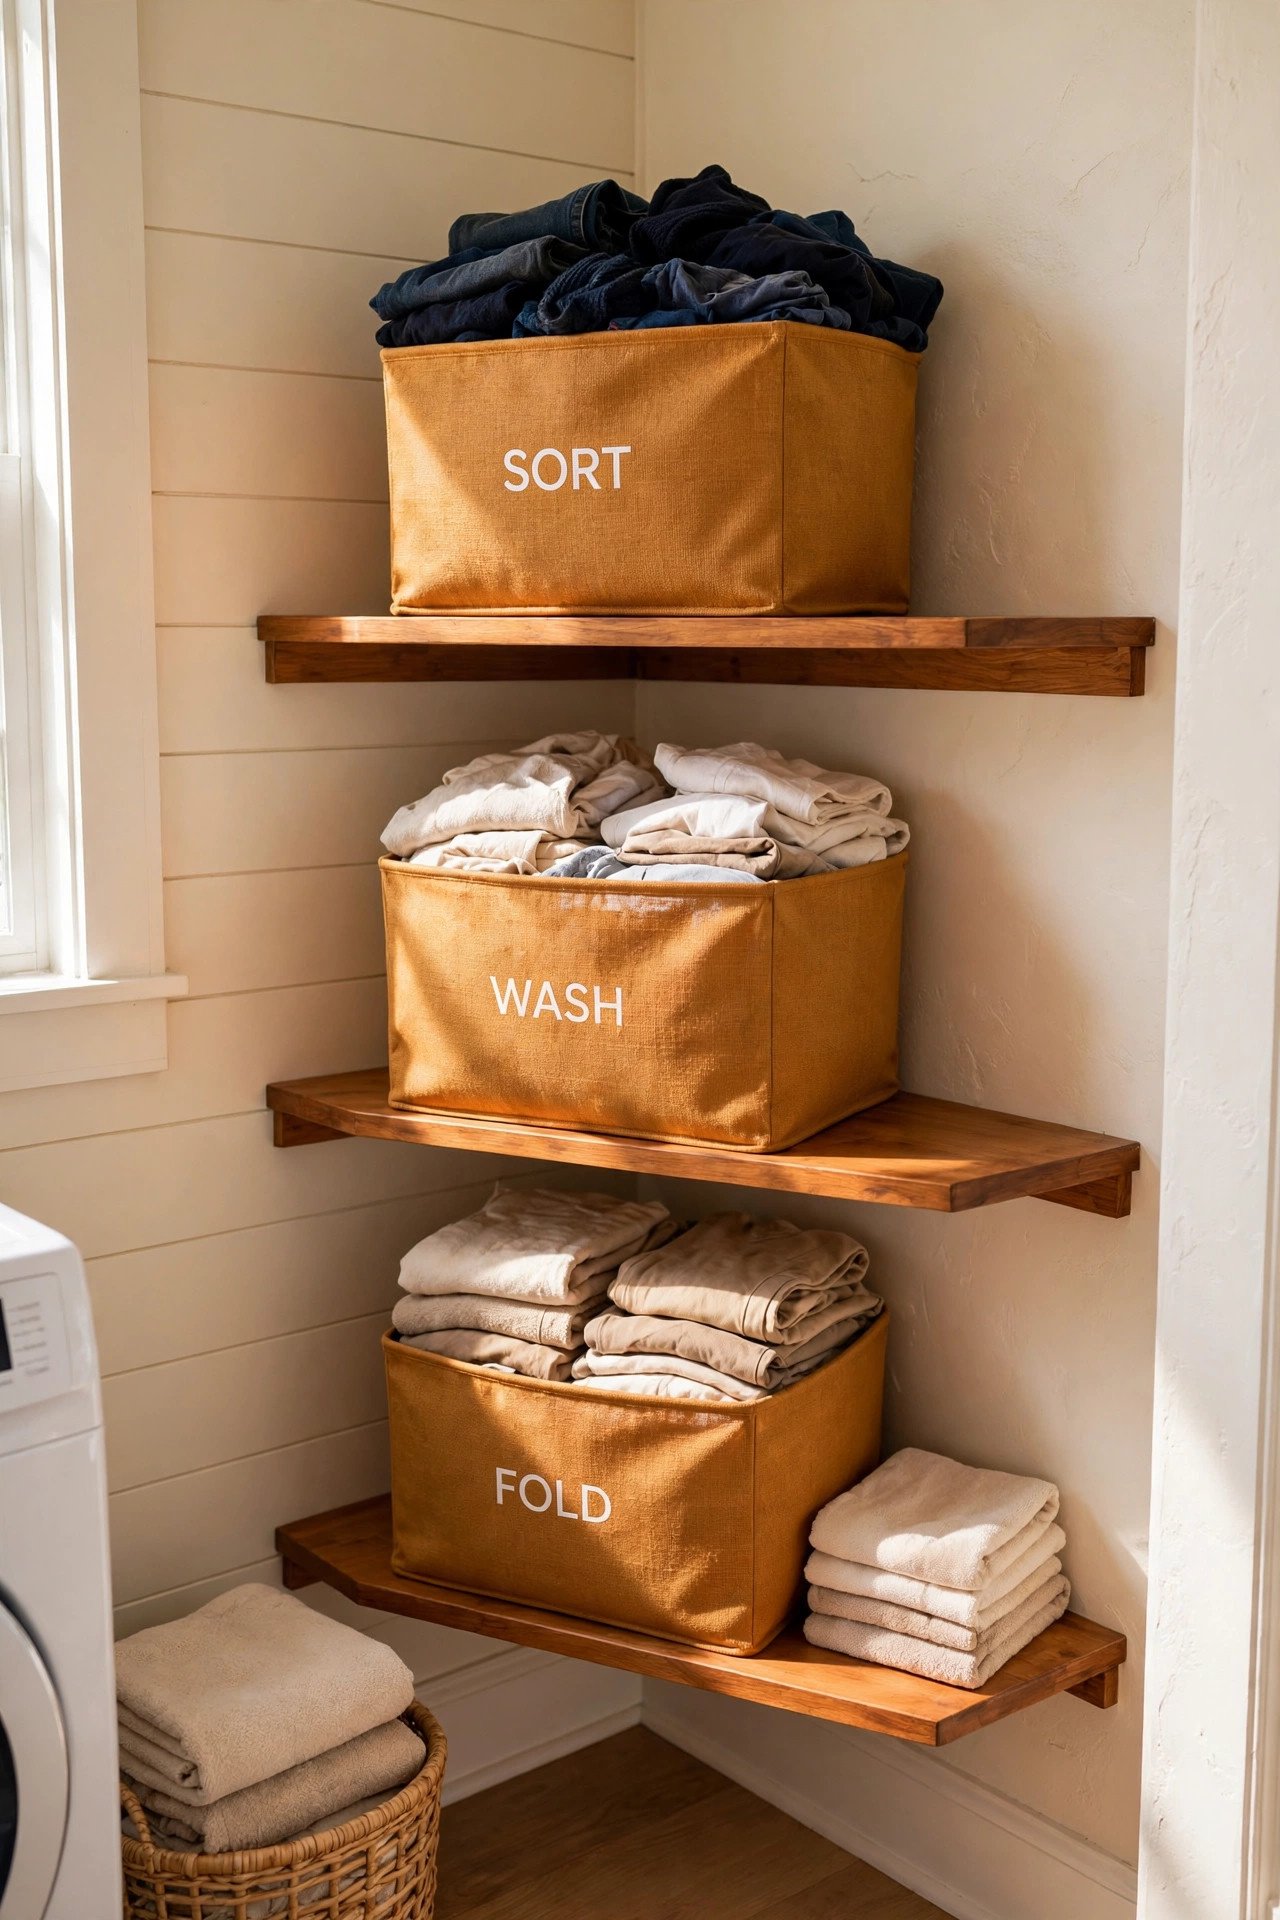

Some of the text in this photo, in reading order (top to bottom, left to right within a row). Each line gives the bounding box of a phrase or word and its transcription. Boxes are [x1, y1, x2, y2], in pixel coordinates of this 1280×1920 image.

[503, 445, 632, 492] SORT
[489, 975, 624, 1027] WASH
[494, 1466, 612, 1524] FOLD
